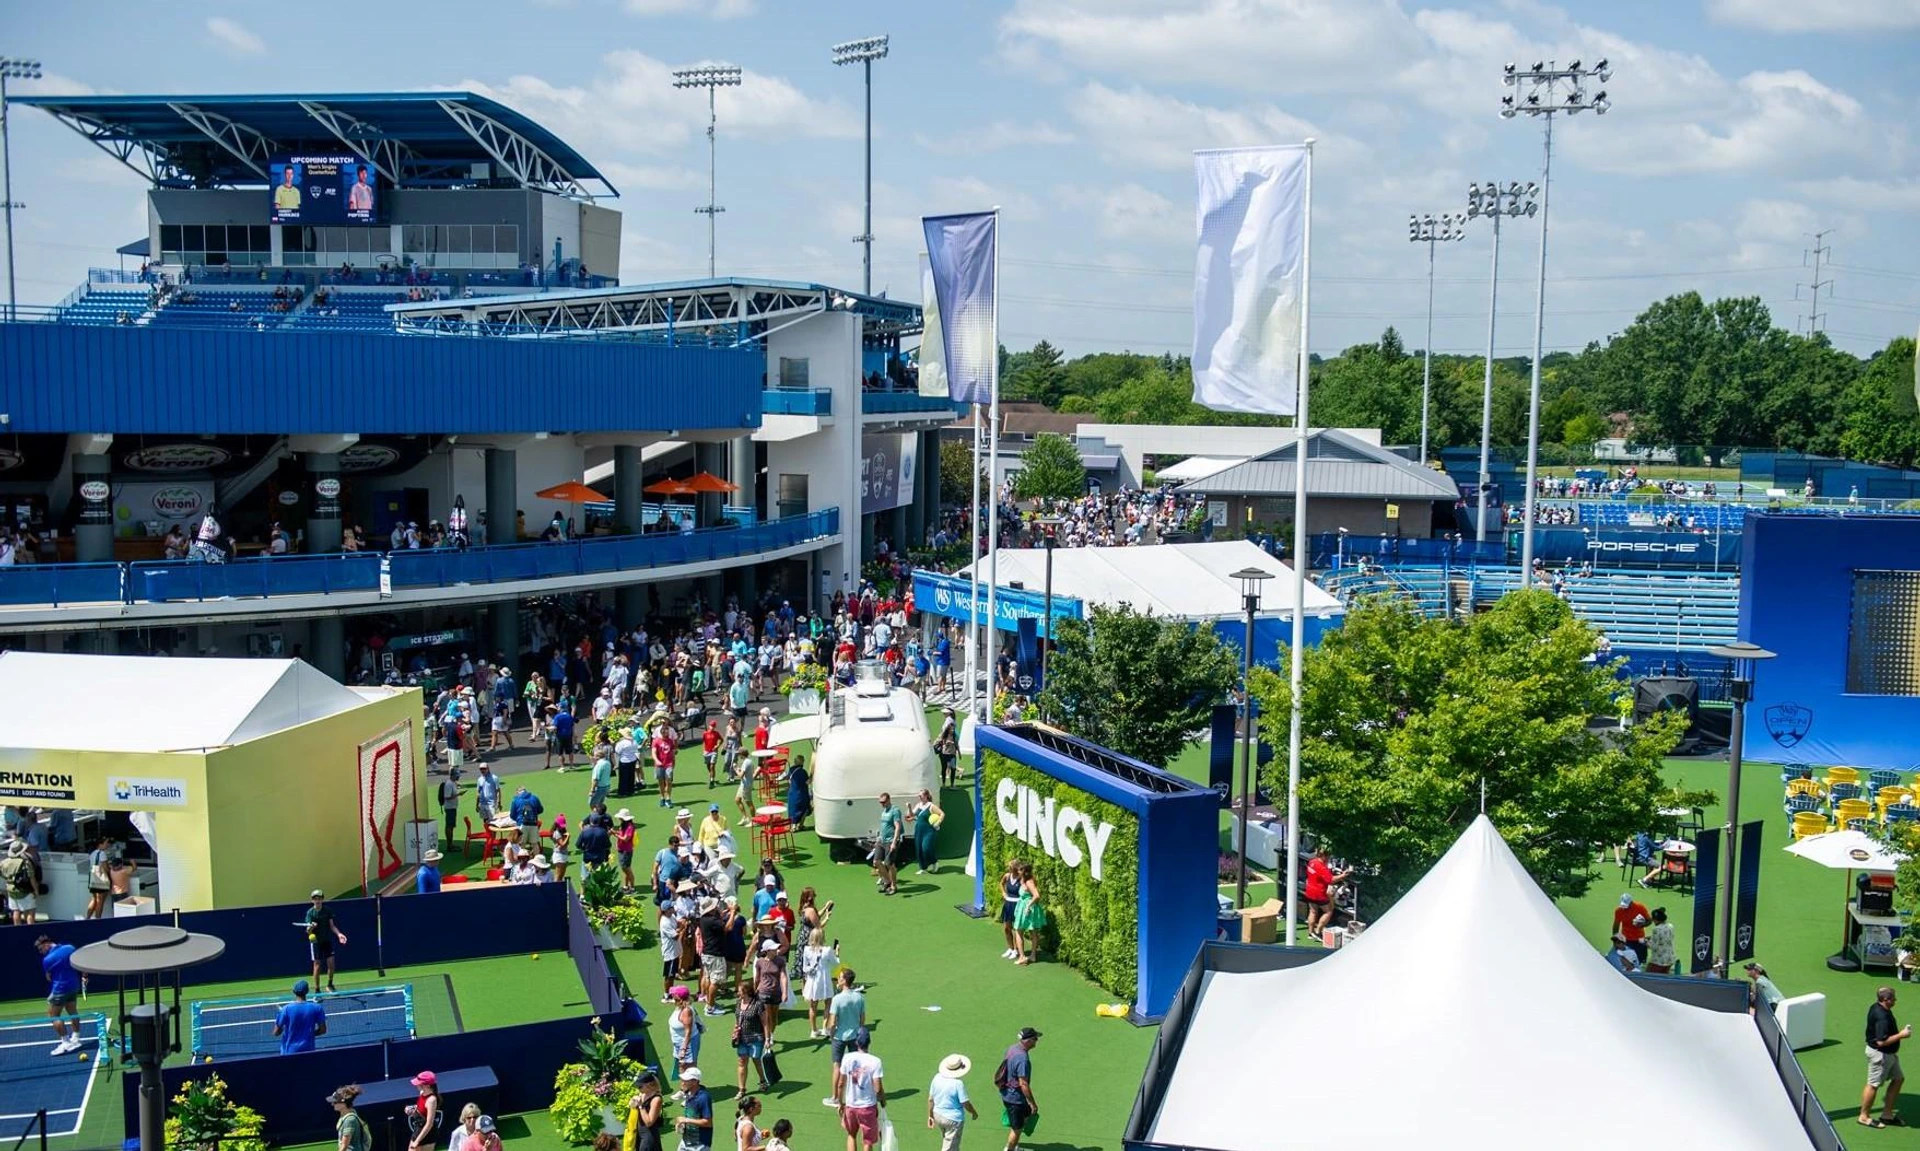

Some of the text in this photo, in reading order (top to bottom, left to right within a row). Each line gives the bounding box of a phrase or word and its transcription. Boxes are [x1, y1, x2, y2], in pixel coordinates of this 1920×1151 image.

[137, 457, 215, 468] Veroni
[83, 488, 107, 496] Veroni
[157, 498, 195, 509] Veroni
[1587, 541, 1696, 553] PORSCHE
[132, 785, 181, 798] TriHealth
[996, 777, 1116, 882] CINCY
